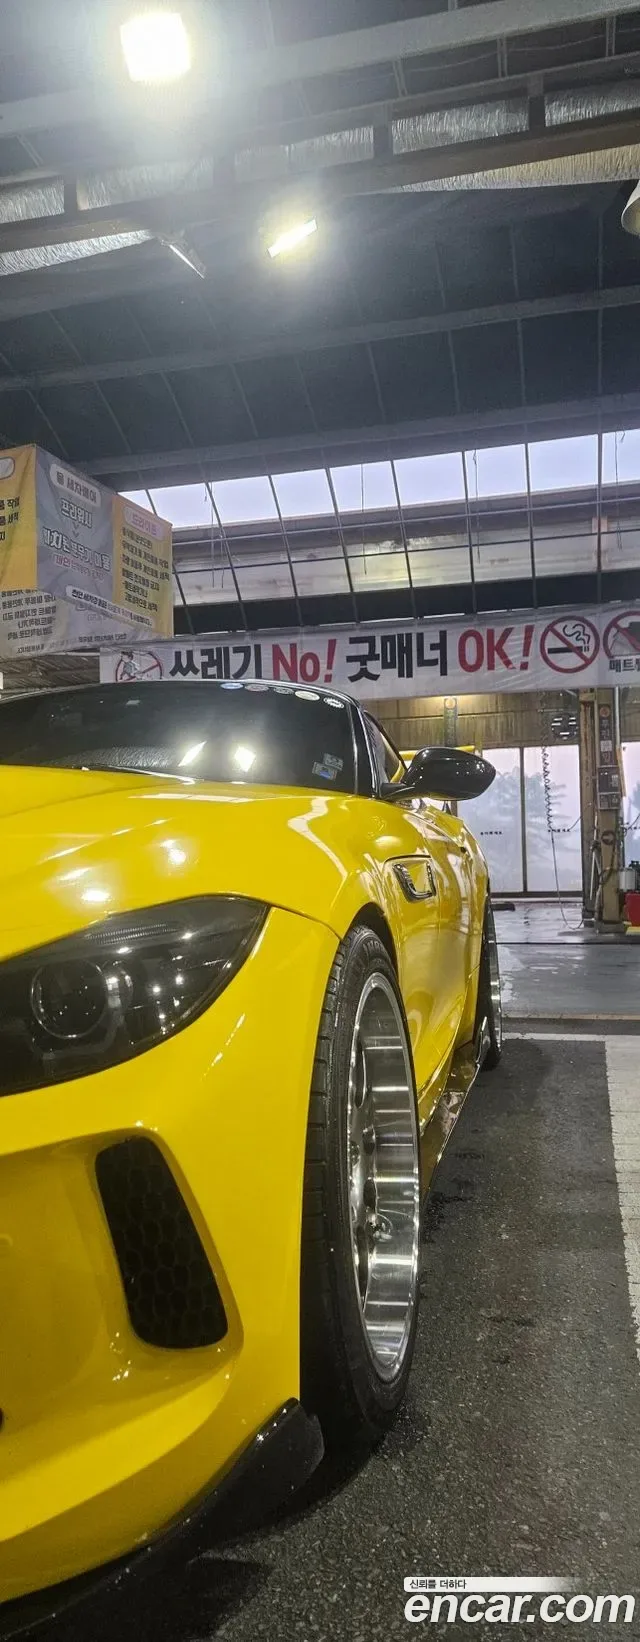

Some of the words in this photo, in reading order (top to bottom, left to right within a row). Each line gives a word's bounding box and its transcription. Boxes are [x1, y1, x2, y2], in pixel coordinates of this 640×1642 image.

[169, 644, 263, 681] 쓰레기
[272, 638, 337, 683] No!
[346, 630, 448, 682] 굿매너
[457, 625, 534, 672] OK!
